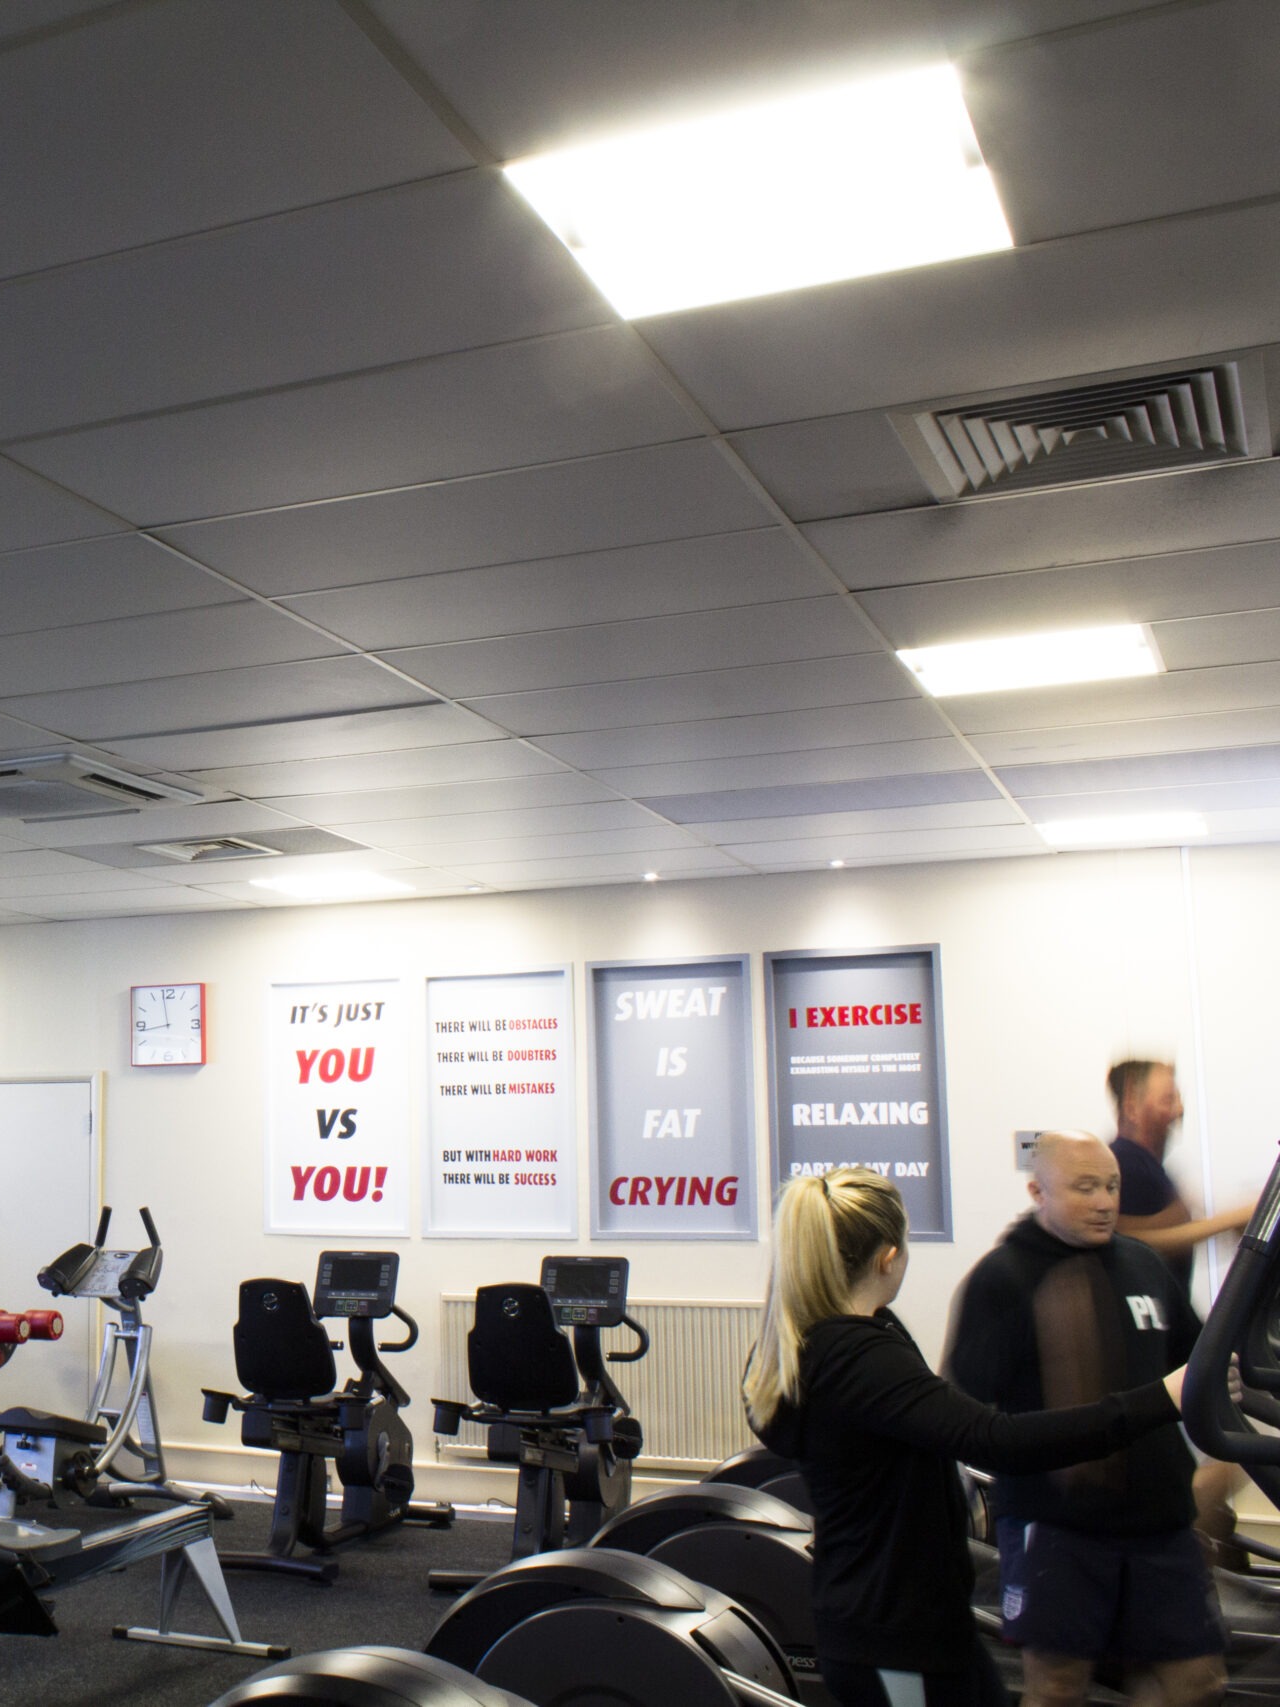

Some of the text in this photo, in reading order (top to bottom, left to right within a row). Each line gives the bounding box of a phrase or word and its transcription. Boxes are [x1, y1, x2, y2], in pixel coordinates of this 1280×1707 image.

[161, 988, 175, 1000] 12
[614, 986, 727, 1021] SWEAT
[136, 1021, 146, 1032] 9
[191, 1019, 201, 1030] 3
[290, 1002, 385, 1028] IT'S JUST
[435, 1018, 558, 1033] THERE WILL BE OBSTACLES
[789, 1003, 923, 1028] I EXERCISE
[296, 1047, 375, 1084] YOU
[437, 1049, 557, 1063] THERE WILL BE DOUBTERS
[656, 1047, 687, 1077] IS
[440, 1082, 555, 1096] THERE WILL BE MISTAKES
[316, 1108, 358, 1139] VS
[642, 1108, 701, 1138] FAT
[792, 1101, 928, 1126] RELAXING
[442, 1150, 558, 1162] BUT WITH HARD WORK
[442, 1173, 557, 1185] THERE WILL BE SUCCESS
[790, 1162, 834, 1177] PART
[894, 1162, 929, 1177] DAY
[290, 1166, 388, 1202] YOU!
[609, 1176, 739, 1206] CRYING
